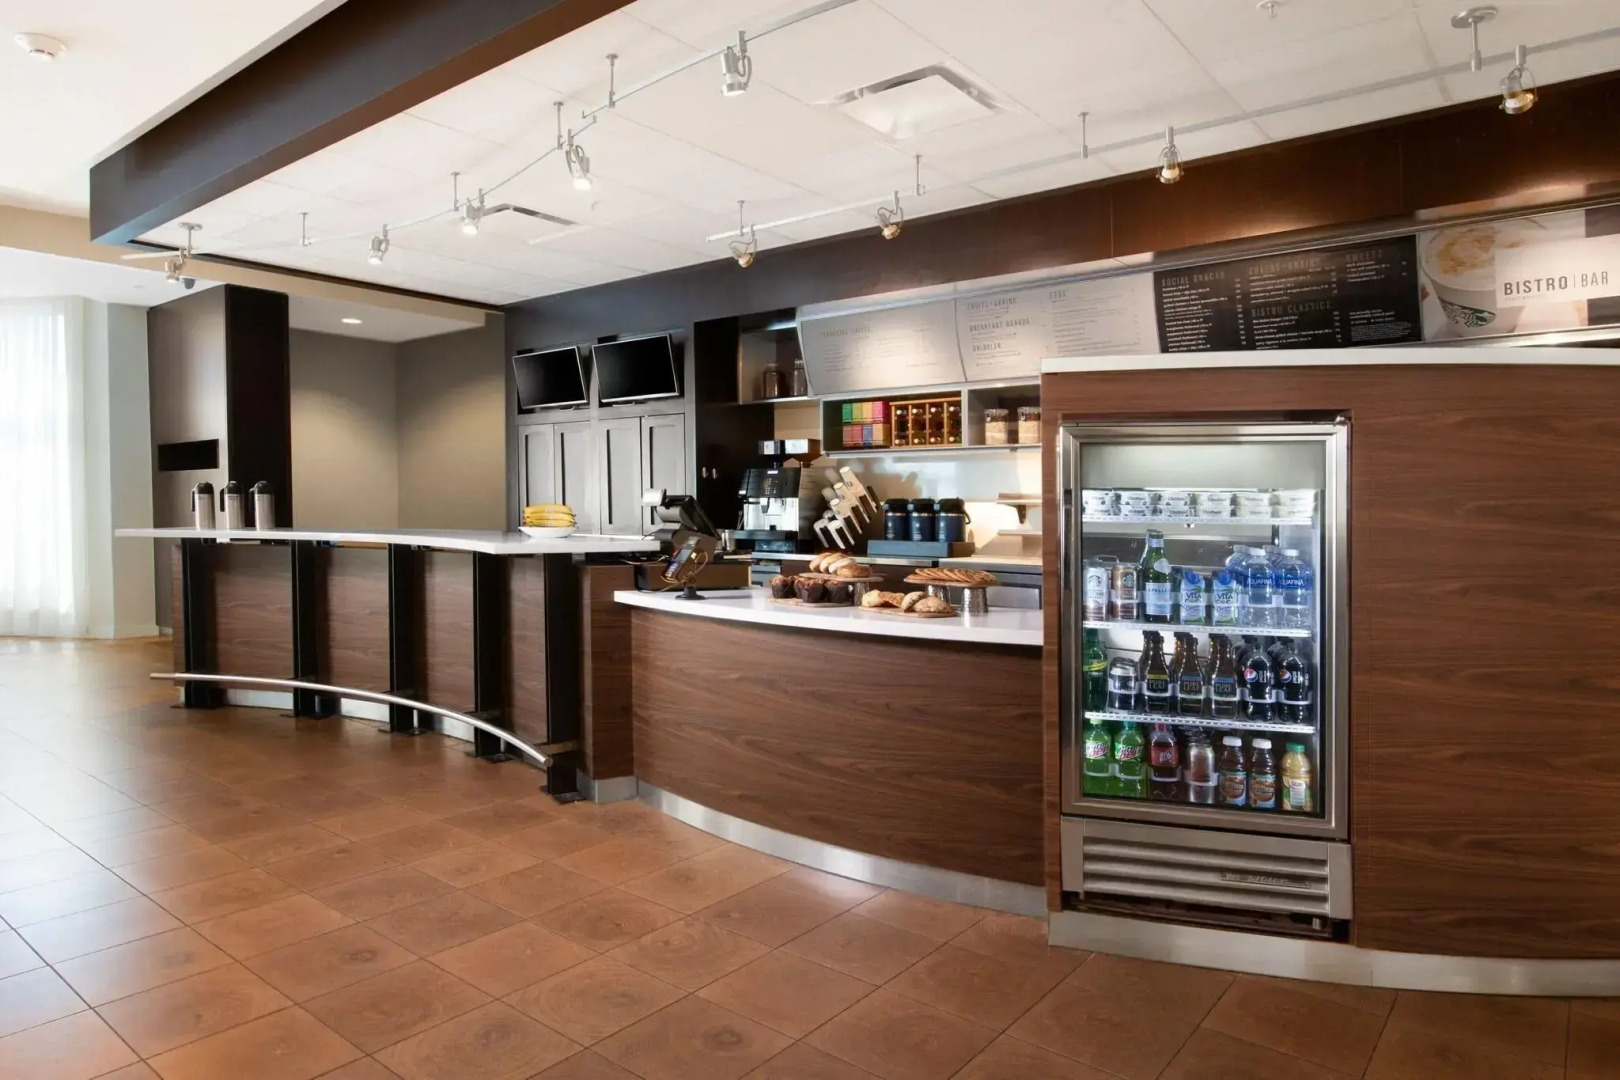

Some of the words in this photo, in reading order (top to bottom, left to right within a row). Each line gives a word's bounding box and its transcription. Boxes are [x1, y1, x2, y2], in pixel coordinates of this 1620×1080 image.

[1161, 275, 1188, 287] SOCIAL
[1193, 270, 1225, 282] SNACKS
[1504, 276, 1568, 296] BISTRO
[1581, 271, 1608, 288] BAR
[1217, 592, 1233, 600] VITA
